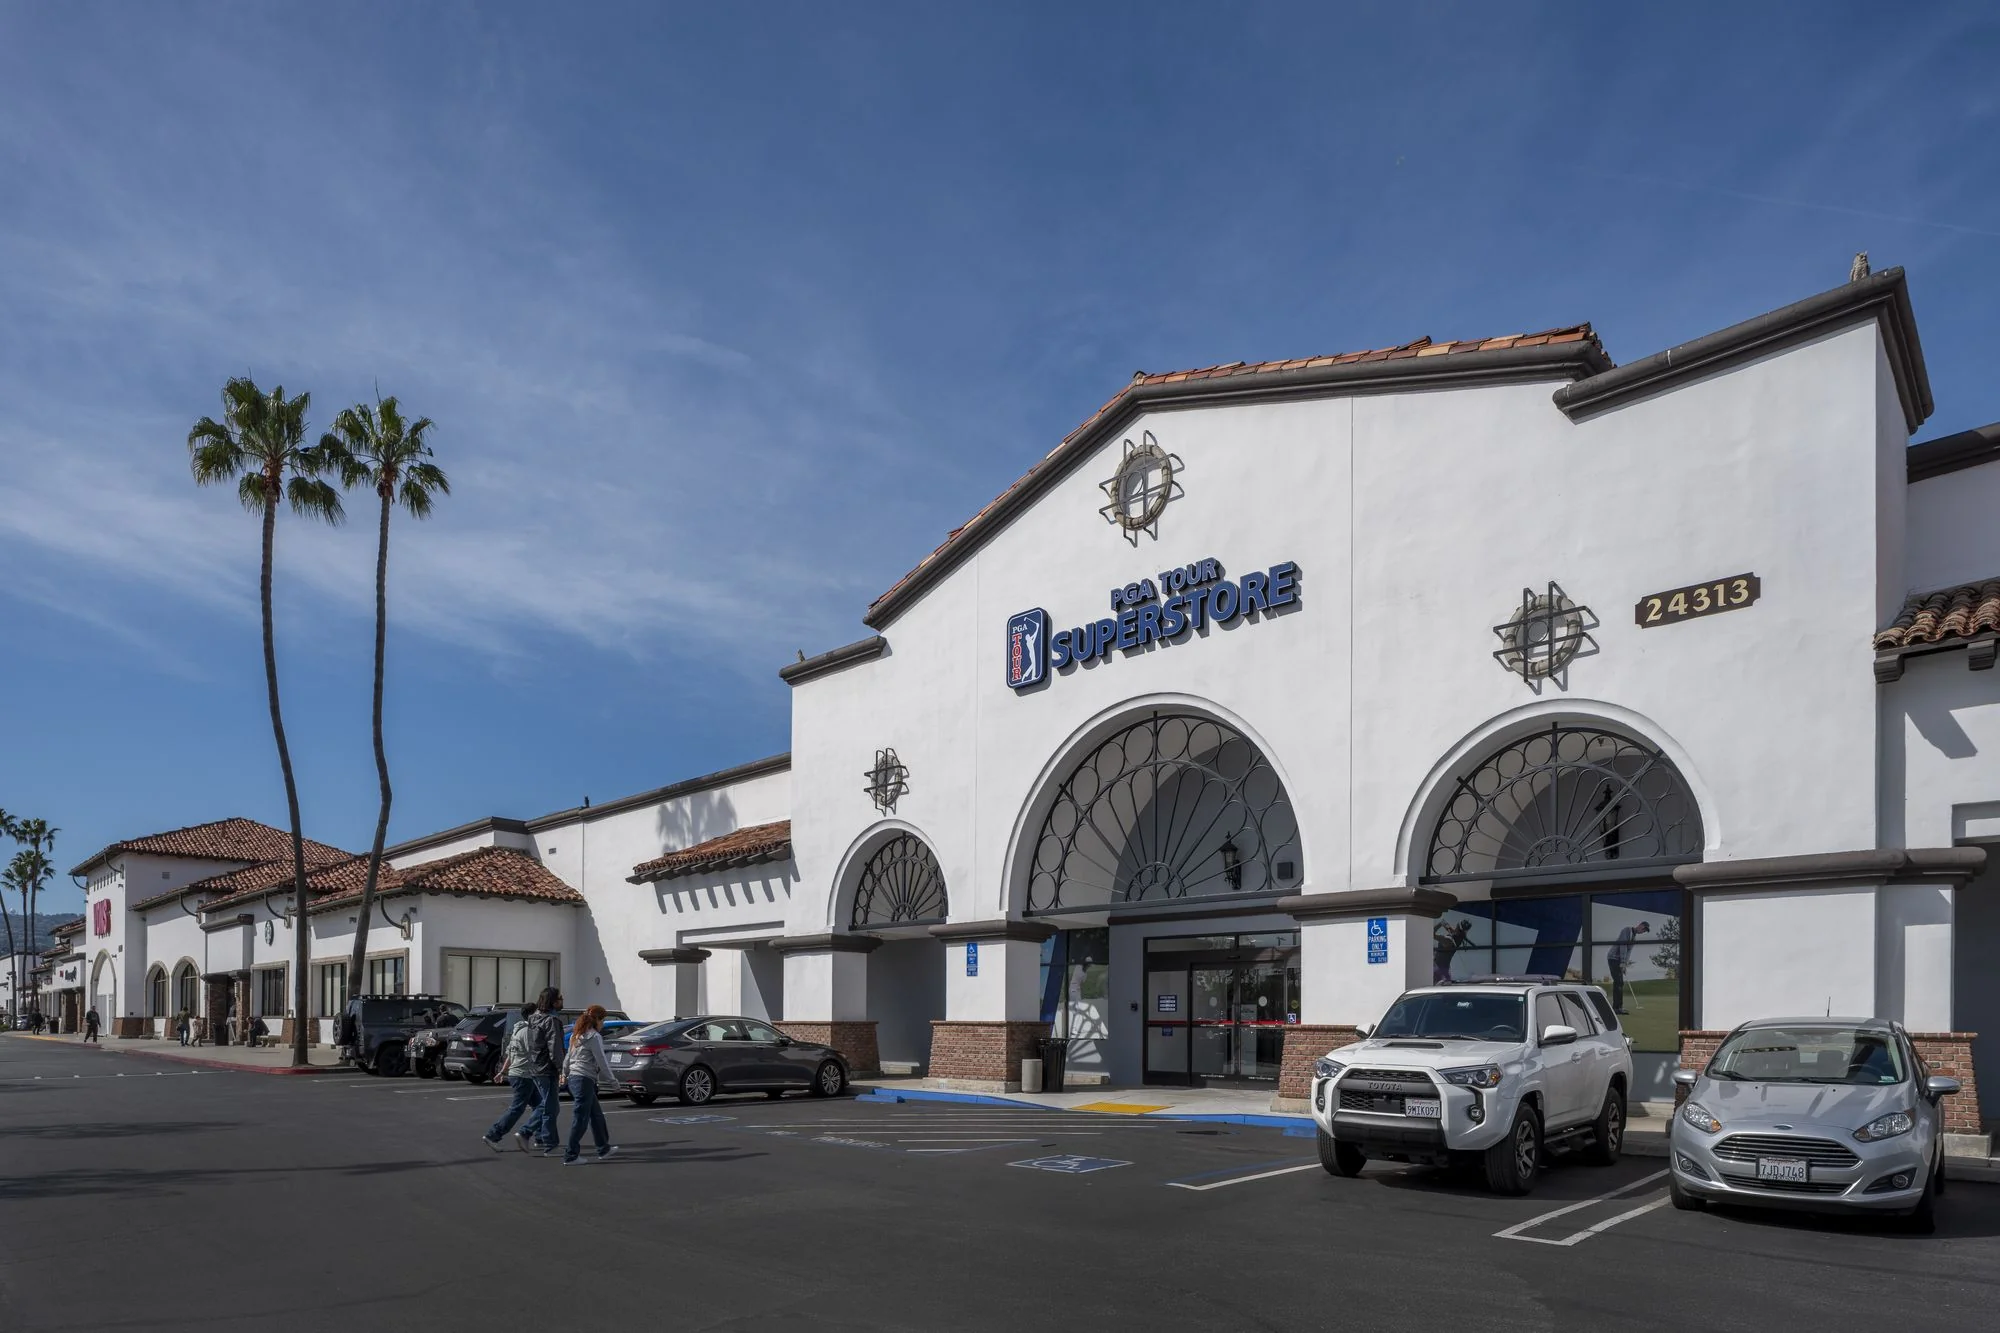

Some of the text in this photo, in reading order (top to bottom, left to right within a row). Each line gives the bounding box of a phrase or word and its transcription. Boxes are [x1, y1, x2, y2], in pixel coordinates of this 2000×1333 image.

[1110, 556, 1219, 611] PGA TOUR
[1051, 560, 1298, 668] SUPERSTORE
[1646, 579, 1749, 622] 24313
[1012, 623, 1028, 634] PGA
[1011, 633, 1023, 681] TOUR
[1367, 1081, 1403, 1092] TOYOTA
[1407, 1105, 1440, 1117] 9MIK097
[1760, 1164, 1804, 1178] 7JDJ748
